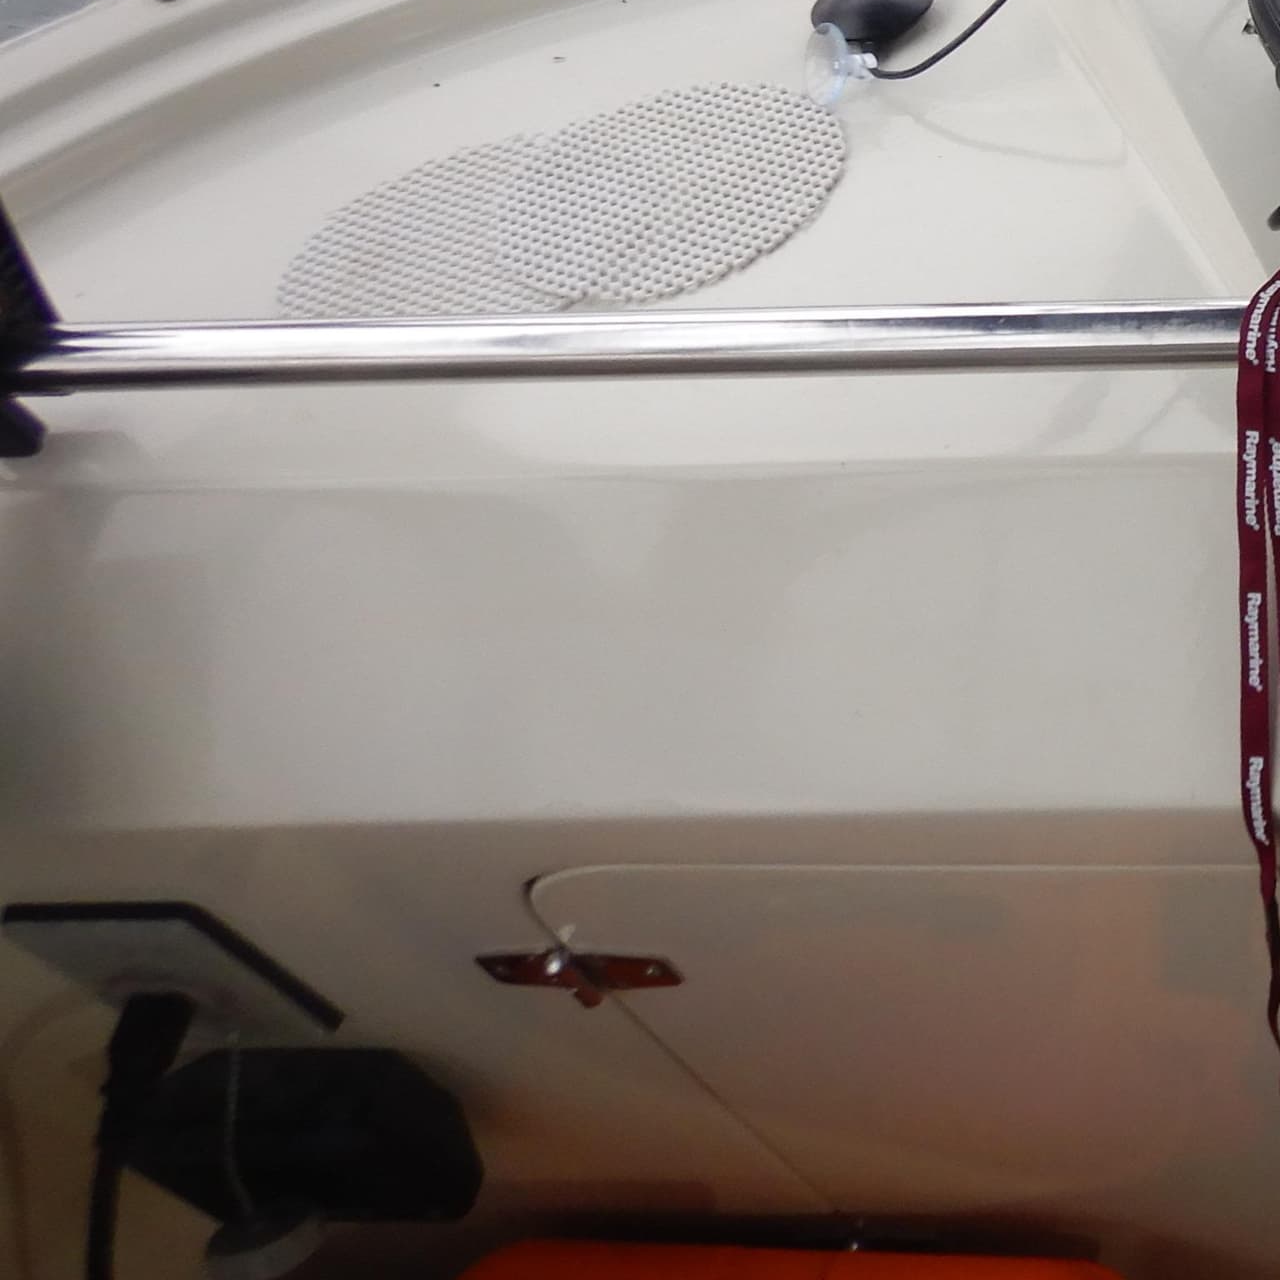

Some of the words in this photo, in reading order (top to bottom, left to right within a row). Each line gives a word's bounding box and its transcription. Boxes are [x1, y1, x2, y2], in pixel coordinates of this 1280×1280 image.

[1242, 430, 1260, 531] Raymarine
[1244, 592, 1263, 692] Raymarine
[1246, 756, 1270, 846] Raymarine
